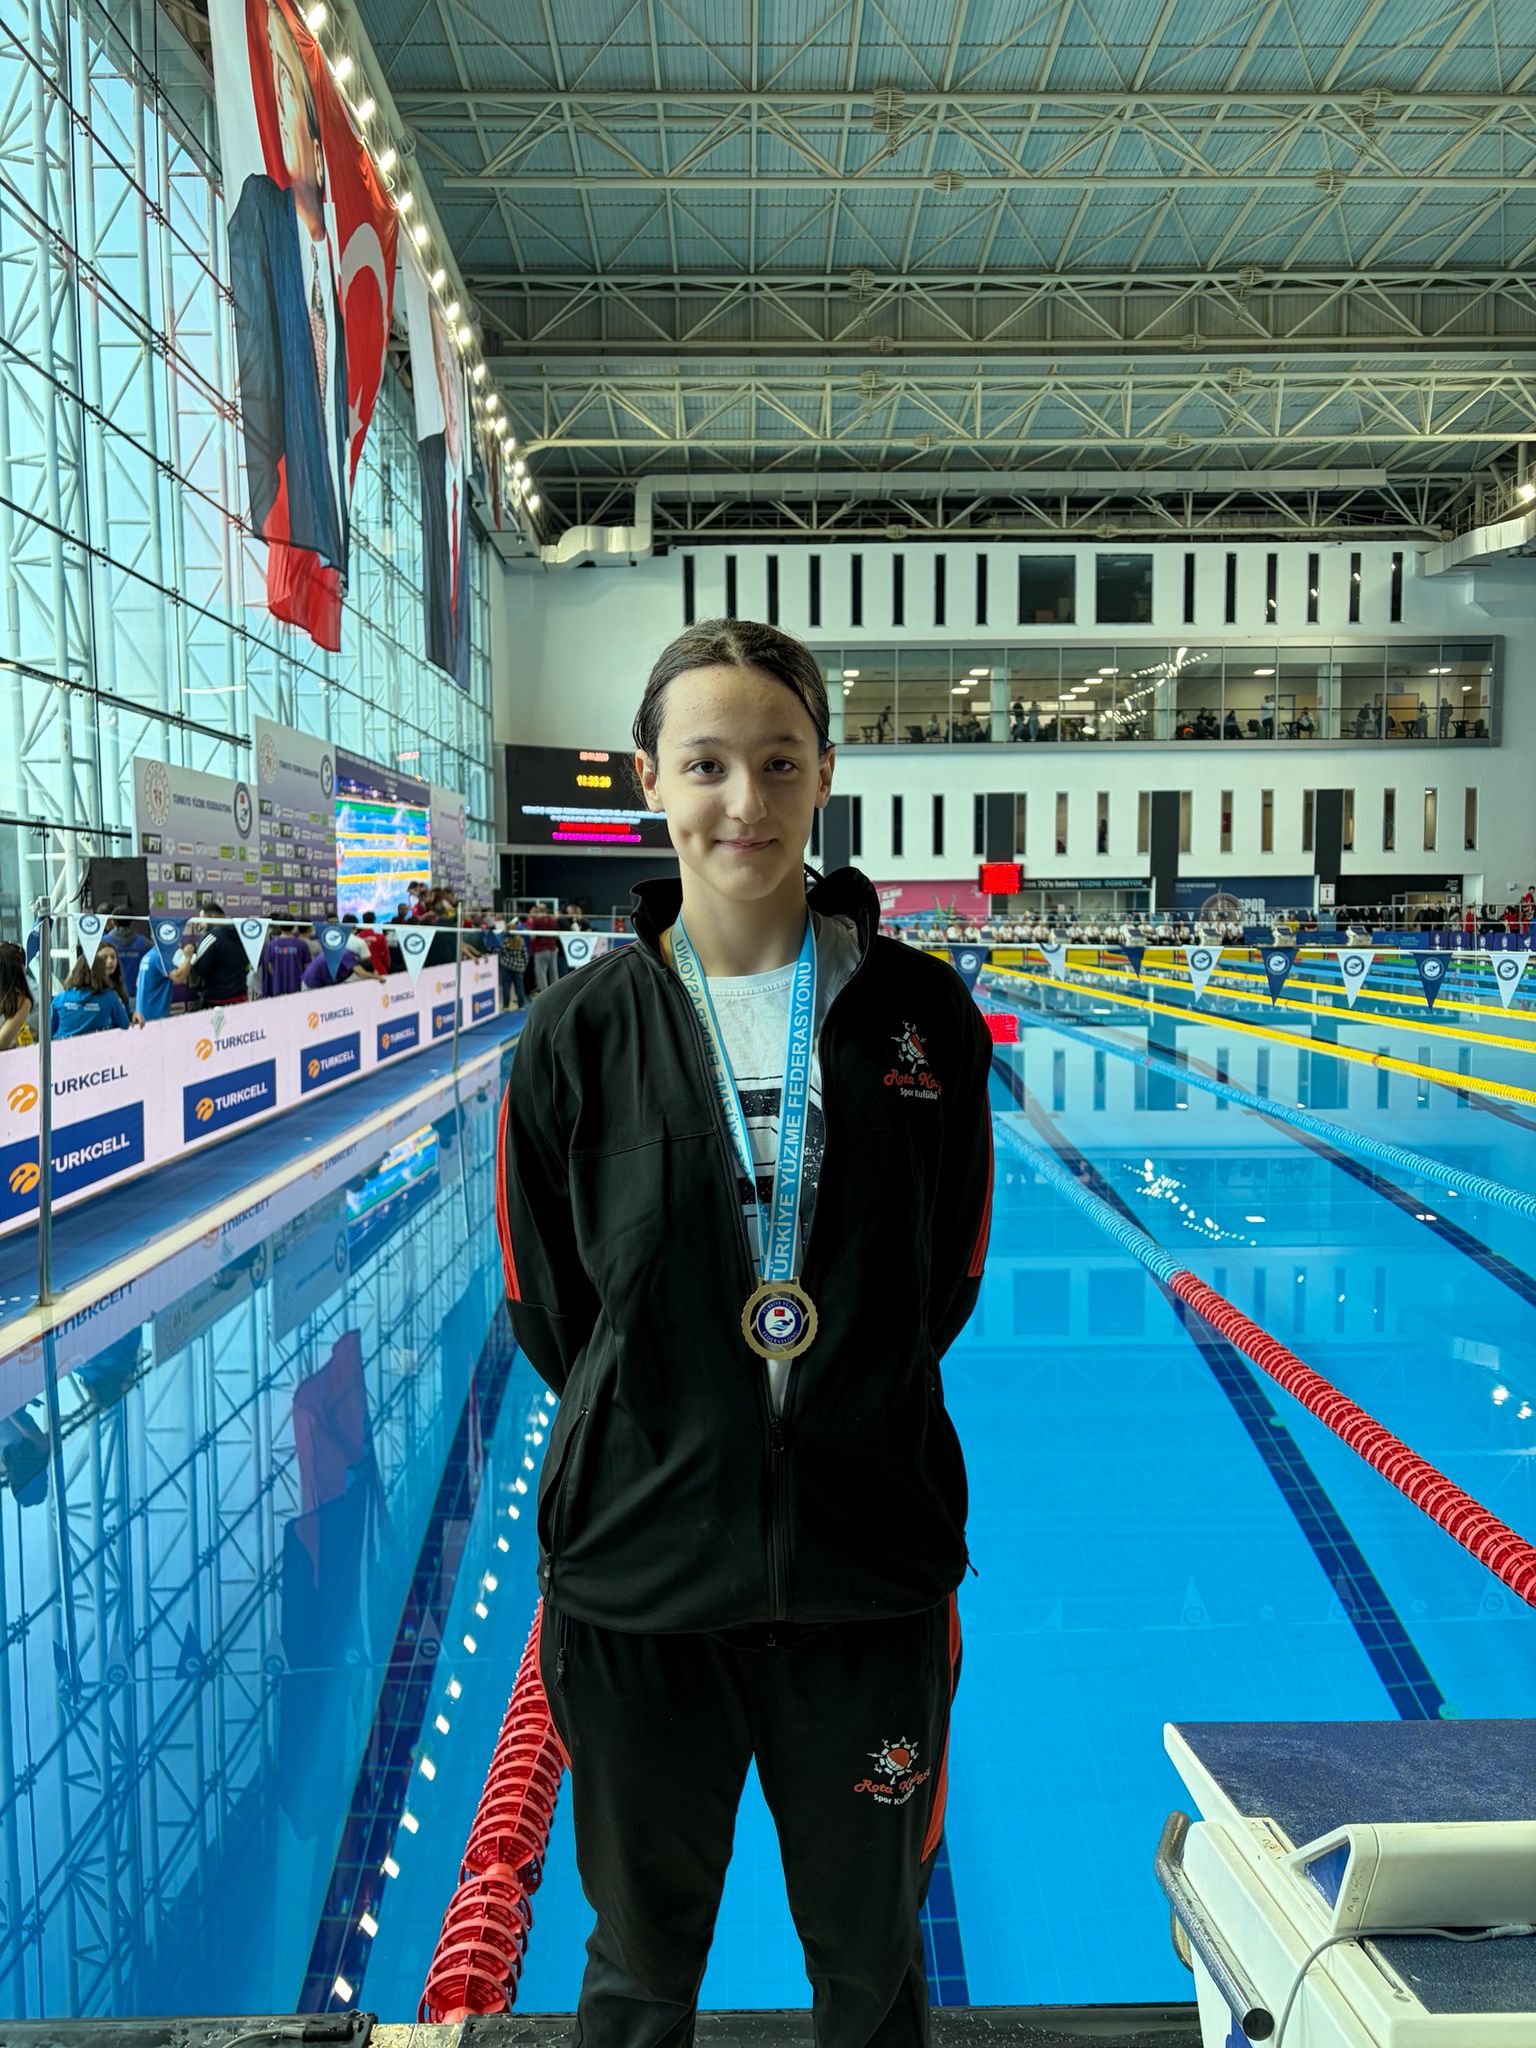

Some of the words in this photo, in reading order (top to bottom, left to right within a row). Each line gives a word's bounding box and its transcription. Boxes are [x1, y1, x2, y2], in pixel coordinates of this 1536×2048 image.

[320, 1006, 354, 1024] TURKCELL
[214, 1028, 267, 1052] TURKCELL
[788, 961, 812, 1109] FEDERASYONU
[320, 1049, 355, 1072] TURKCELL
[51, 1065, 128, 1096] URKCELL
[214, 1081, 268, 1112] TURKCELL
[51, 1132, 130, 1174] URKCELL
[778, 1114, 801, 1188] YÜZME
[770, 1194, 794, 1281] TÜRKİYE
[873, 1794, 892, 1805] Spor
